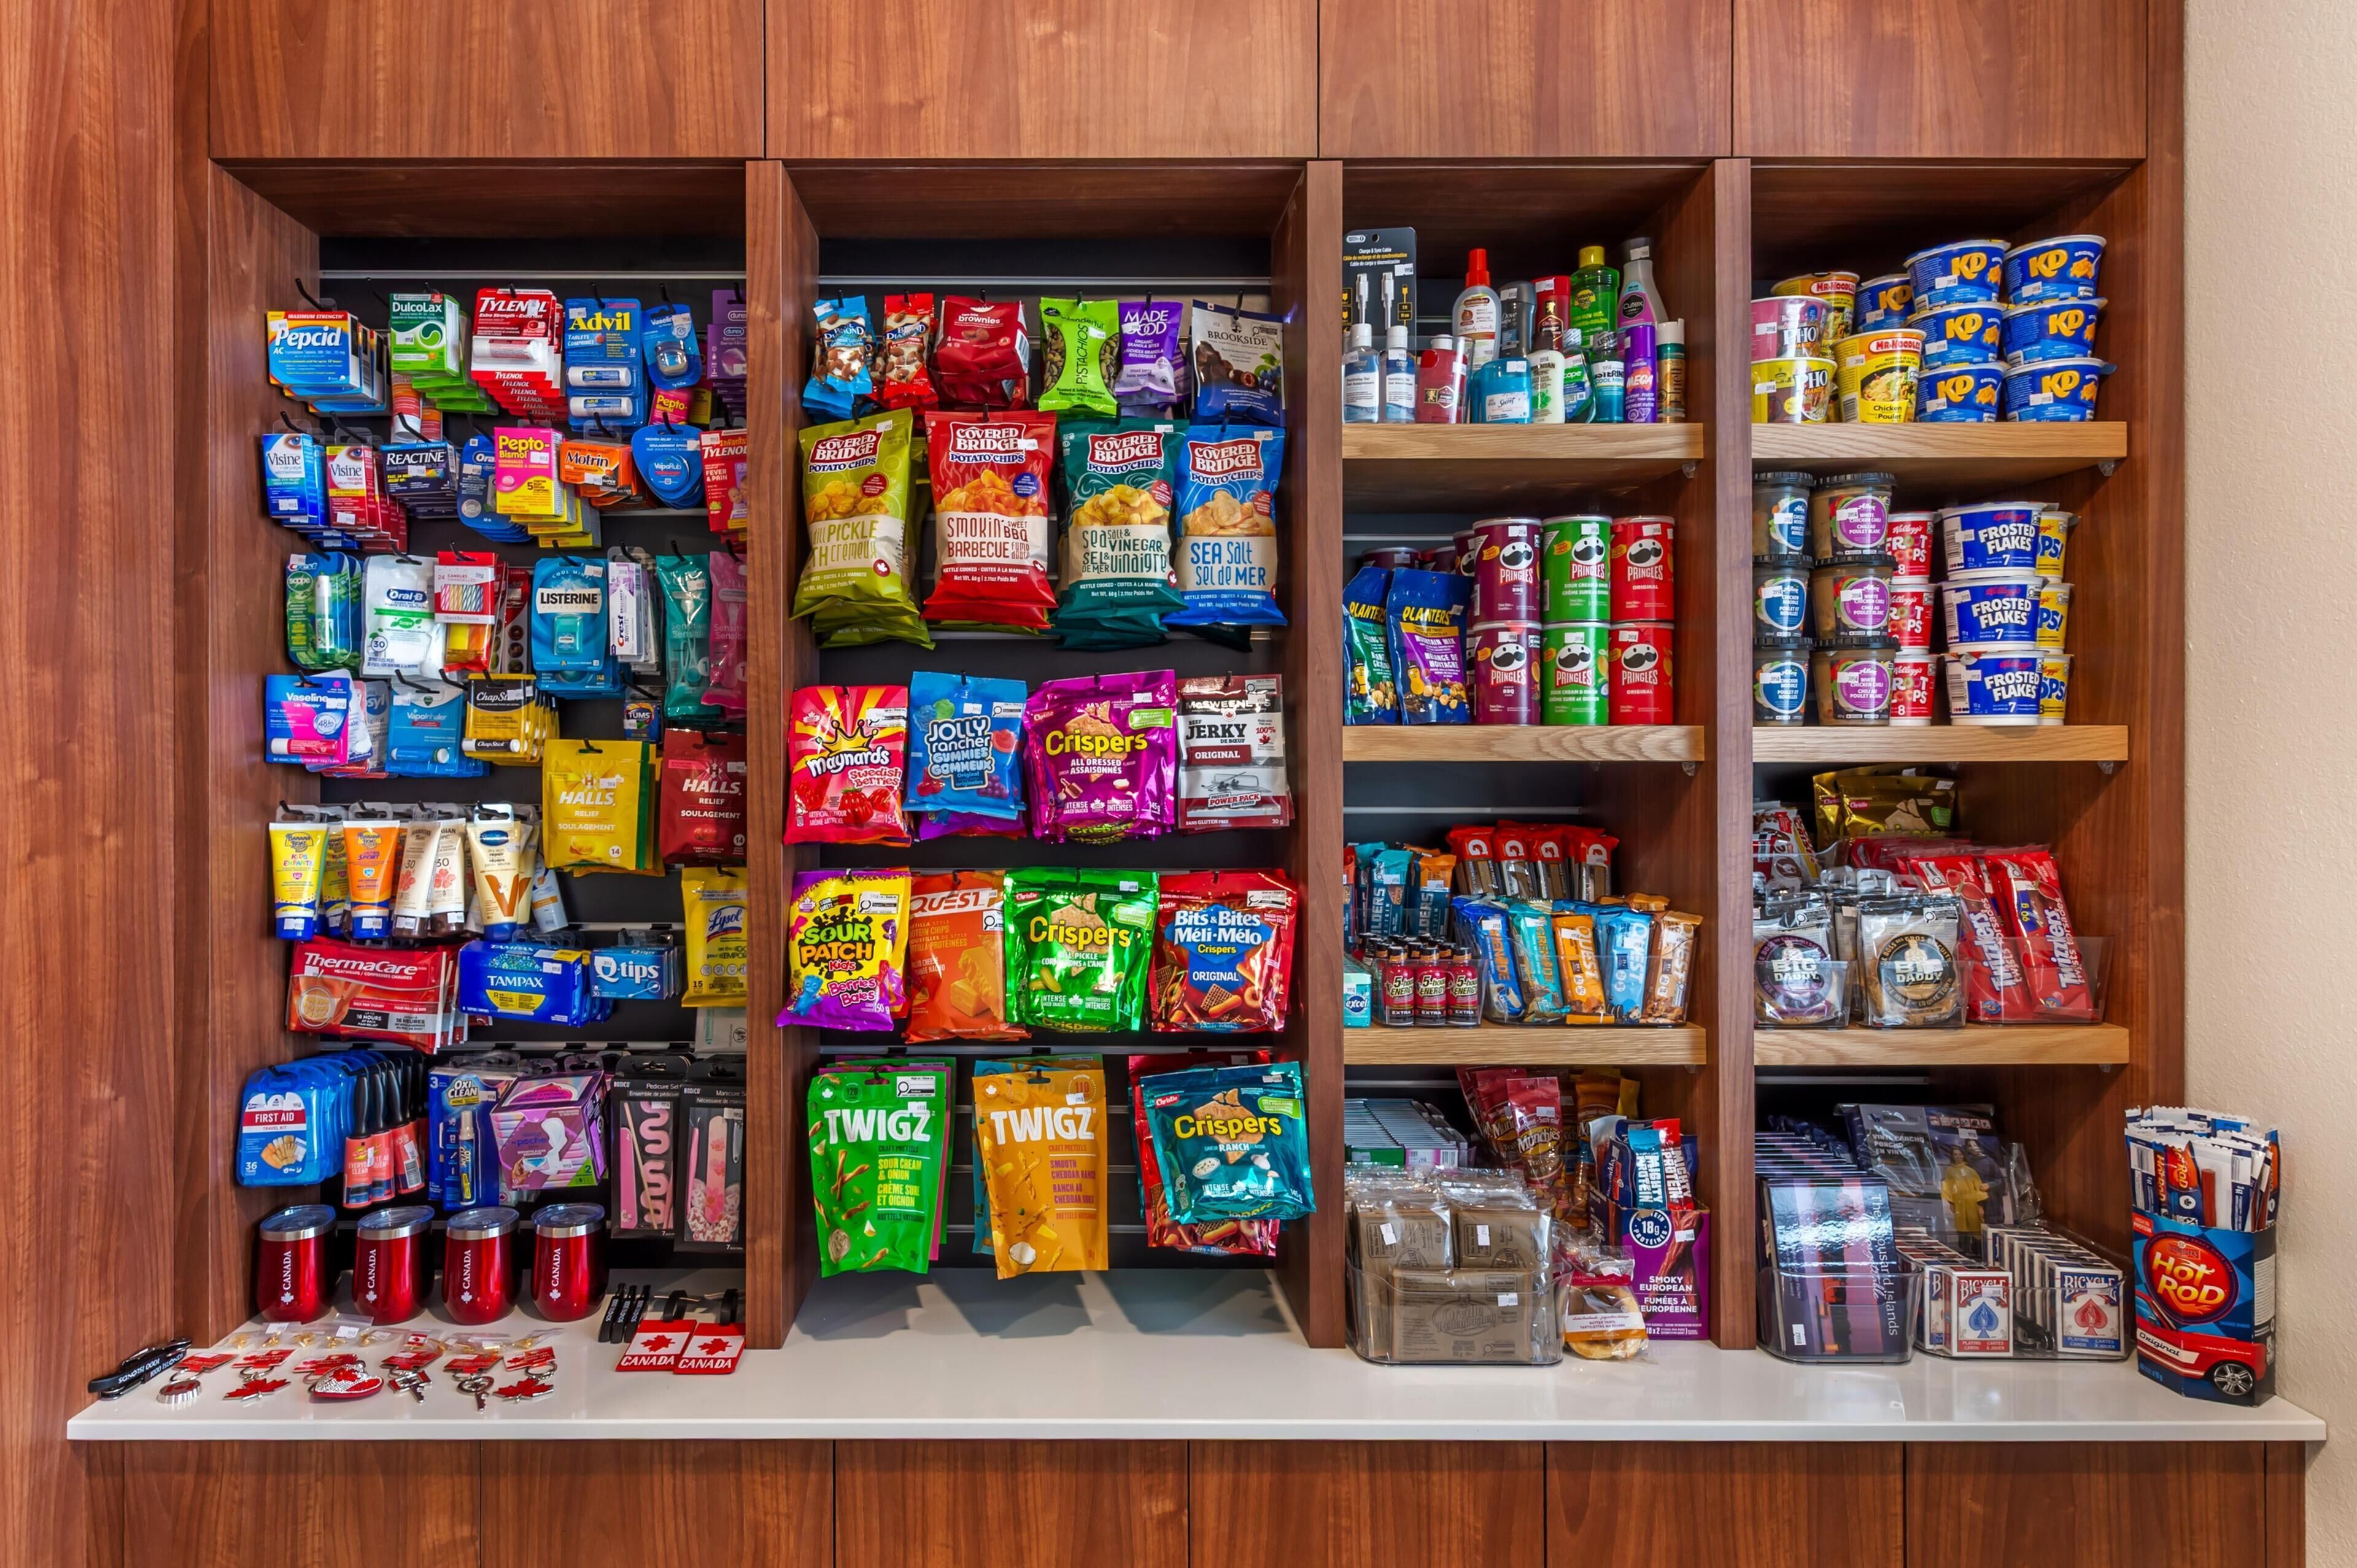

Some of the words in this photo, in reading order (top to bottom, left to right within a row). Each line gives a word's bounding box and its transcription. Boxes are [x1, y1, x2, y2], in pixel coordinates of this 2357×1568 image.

[1951, 252, 1987, 279] KD
[2029, 249, 2068, 277] KD
[1623, 299, 1644, 309] Cutex
[569, 312, 631, 331] Advil
[958, 315, 1000, 325] brownies
[1124, 310, 1169, 323] MADE
[2049, 309, 2084, 336] KD
[276, 326, 341, 350] Pepcid
[1207, 330, 1268, 346] BROOKSIDE
[1627, 373, 1654, 387] MEGA
[498, 435, 550, 451] Pepto-
[386, 452, 444, 464] REACTINE
[498, 450, 528, 459] Bismol
[950, 454, 991, 463] POTATO
[993, 454, 1024, 463] CHIPS
[1194, 445, 1255, 458] COVERED
[565, 451, 609, 467] Motrin
[1195, 455, 1256, 473] BRIDGE
[330, 465, 362, 477] Visine
[827, 520, 879, 541] PICKLE
[1892, 524, 1923, 535] Kellogg's
[1978, 523, 2035, 543] FROSTED
[948, 541, 1009, 558] BARBECUE
[1109, 539, 1163, 553] VINEGAR
[1986, 538, 2032, 554] FLAKES
[1191, 543, 1221, 564] SEA
[2002, 554, 2010, 565] 7
[1500, 568, 1533, 584] PRINGLES
[1572, 563, 1604, 579] PRINGLES
[1628, 565, 1663, 581] PRINGLES
[1898, 564, 1906, 574] 8
[1234, 567, 1266, 586] MER
[389, 591, 423, 601] Oral-B
[540, 593, 599, 604] LISTERINE
[1403, 606, 1450, 625] PLANTERS
[1417, 636, 1441, 644] MOUNTAIN
[1491, 670, 1526, 686] PRINGLES
[286, 692, 328, 702] Vaseline
[628, 711, 651, 720] TUMS
[930, 719, 988, 741] JOLLY
[1186, 724, 1247, 740] JERKY
[932, 737, 991, 752] rancher
[1045, 730, 1148, 756] Crispers
[932, 748, 988, 762] GUMMIES
[849, 768, 902, 779] Swedish
[1070, 765, 1122, 774] ASSAISONNÉS
[682, 779, 740, 794] HALLS
[854, 777, 899, 788] Berries
[559, 792, 614, 806] HALLS
[681, 810, 740, 819] SOULAGEMENT
[708, 908, 742, 931] Lysol
[1174, 911, 1207, 926] Bits
[1218, 911, 1261, 926] Bites
[804, 926, 871, 943] SOUR
[1029, 916, 1131, 950] Crispers
[1174, 927, 1262, 944] Méli-Mélo
[800, 943, 874, 964] PATCH
[1198, 944, 1237, 954] Crispers
[2044, 908, 2083, 989] Twizzlers
[304, 952, 418, 976] ThermaCare
[594, 957, 660, 984] Q-tips
[829, 960, 856, 971] Kids
[1772, 959, 1817, 972] BIG
[487, 976, 544, 988] TAMPAX
[1193, 971, 1239, 982] ORIGINAL
[1896, 971, 1942, 983] DADDY
[829, 978, 876, 994] Berries
[430, 1076, 438, 1089] 3
[454, 1079, 471, 1089] OXI
[447, 1087, 479, 1099] CLEAN
[1156, 1095, 1178, 1106] Christie
[255, 1113, 279, 1122] FIRST
[281, 1112, 295, 1122] AID
[824, 1110, 931, 1143] TWIGZ
[990, 1107, 1095, 1145] TWIGZ
[1174, 1114, 1282, 1139] Crispers
[517, 1137, 546, 1146] poche
[1219, 1143, 1250, 1152] RANCH
[1518, 1129, 1560, 1153] Munchies
[584, 1165, 592, 1173] 2
[878, 1159, 895, 1170] SOUR
[896, 1159, 922, 1170] CREAM
[1050, 1159, 1077, 1168] SMOOTH
[888, 1170, 910, 1181] ONION
[1636, 1155, 1654, 1202] PROTEIN
[1645, 1155, 1663, 1203] MIGHTY
[1642, 1222, 1660, 1235] 18g
[1633, 1229, 1668, 1245] PROTÉINES
[368, 1249, 376, 1289] CANADA
[552, 1248, 560, 1288] CANADA
[1644, 1296, 1678, 1305] FUMÉES
[1884, 1288, 1899, 1336] Islands
[2138, 1331, 2180, 1358] Original
[145, 1358, 160, 1370] 1000
[621, 1356, 675, 1367] CANADA
[678, 1358, 732, 1369] CANADA
